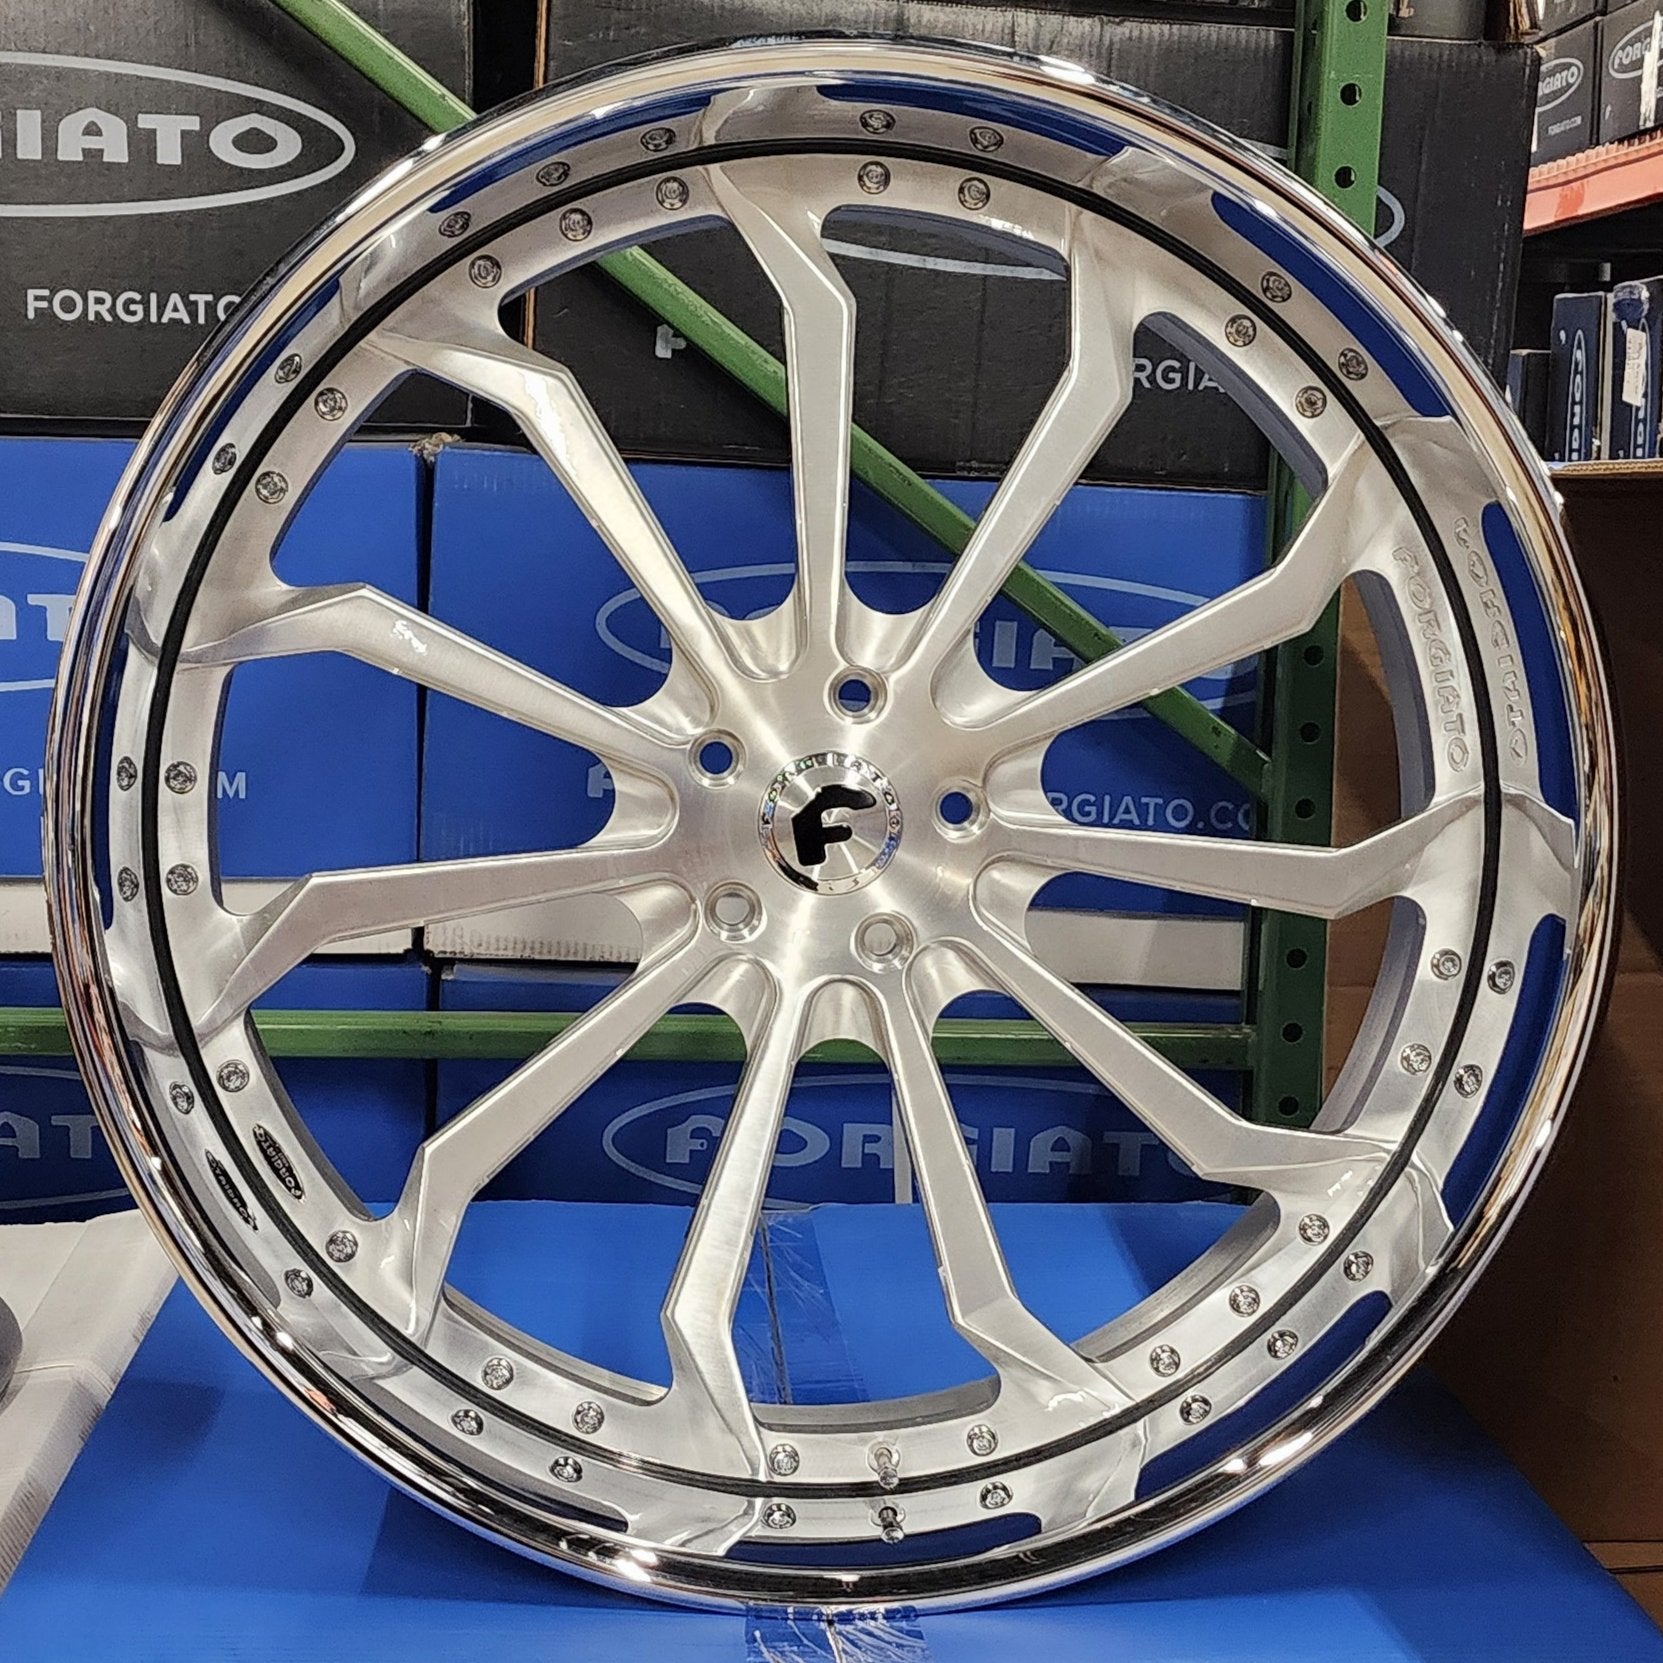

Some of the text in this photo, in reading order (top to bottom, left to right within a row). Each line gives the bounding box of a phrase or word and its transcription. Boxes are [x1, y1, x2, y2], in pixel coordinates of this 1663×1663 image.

[0, 107, 302, 169] IATO
[1392, 546, 1469, 773] FORGIATO
[665, 1114, 1197, 1178] FORIAT
